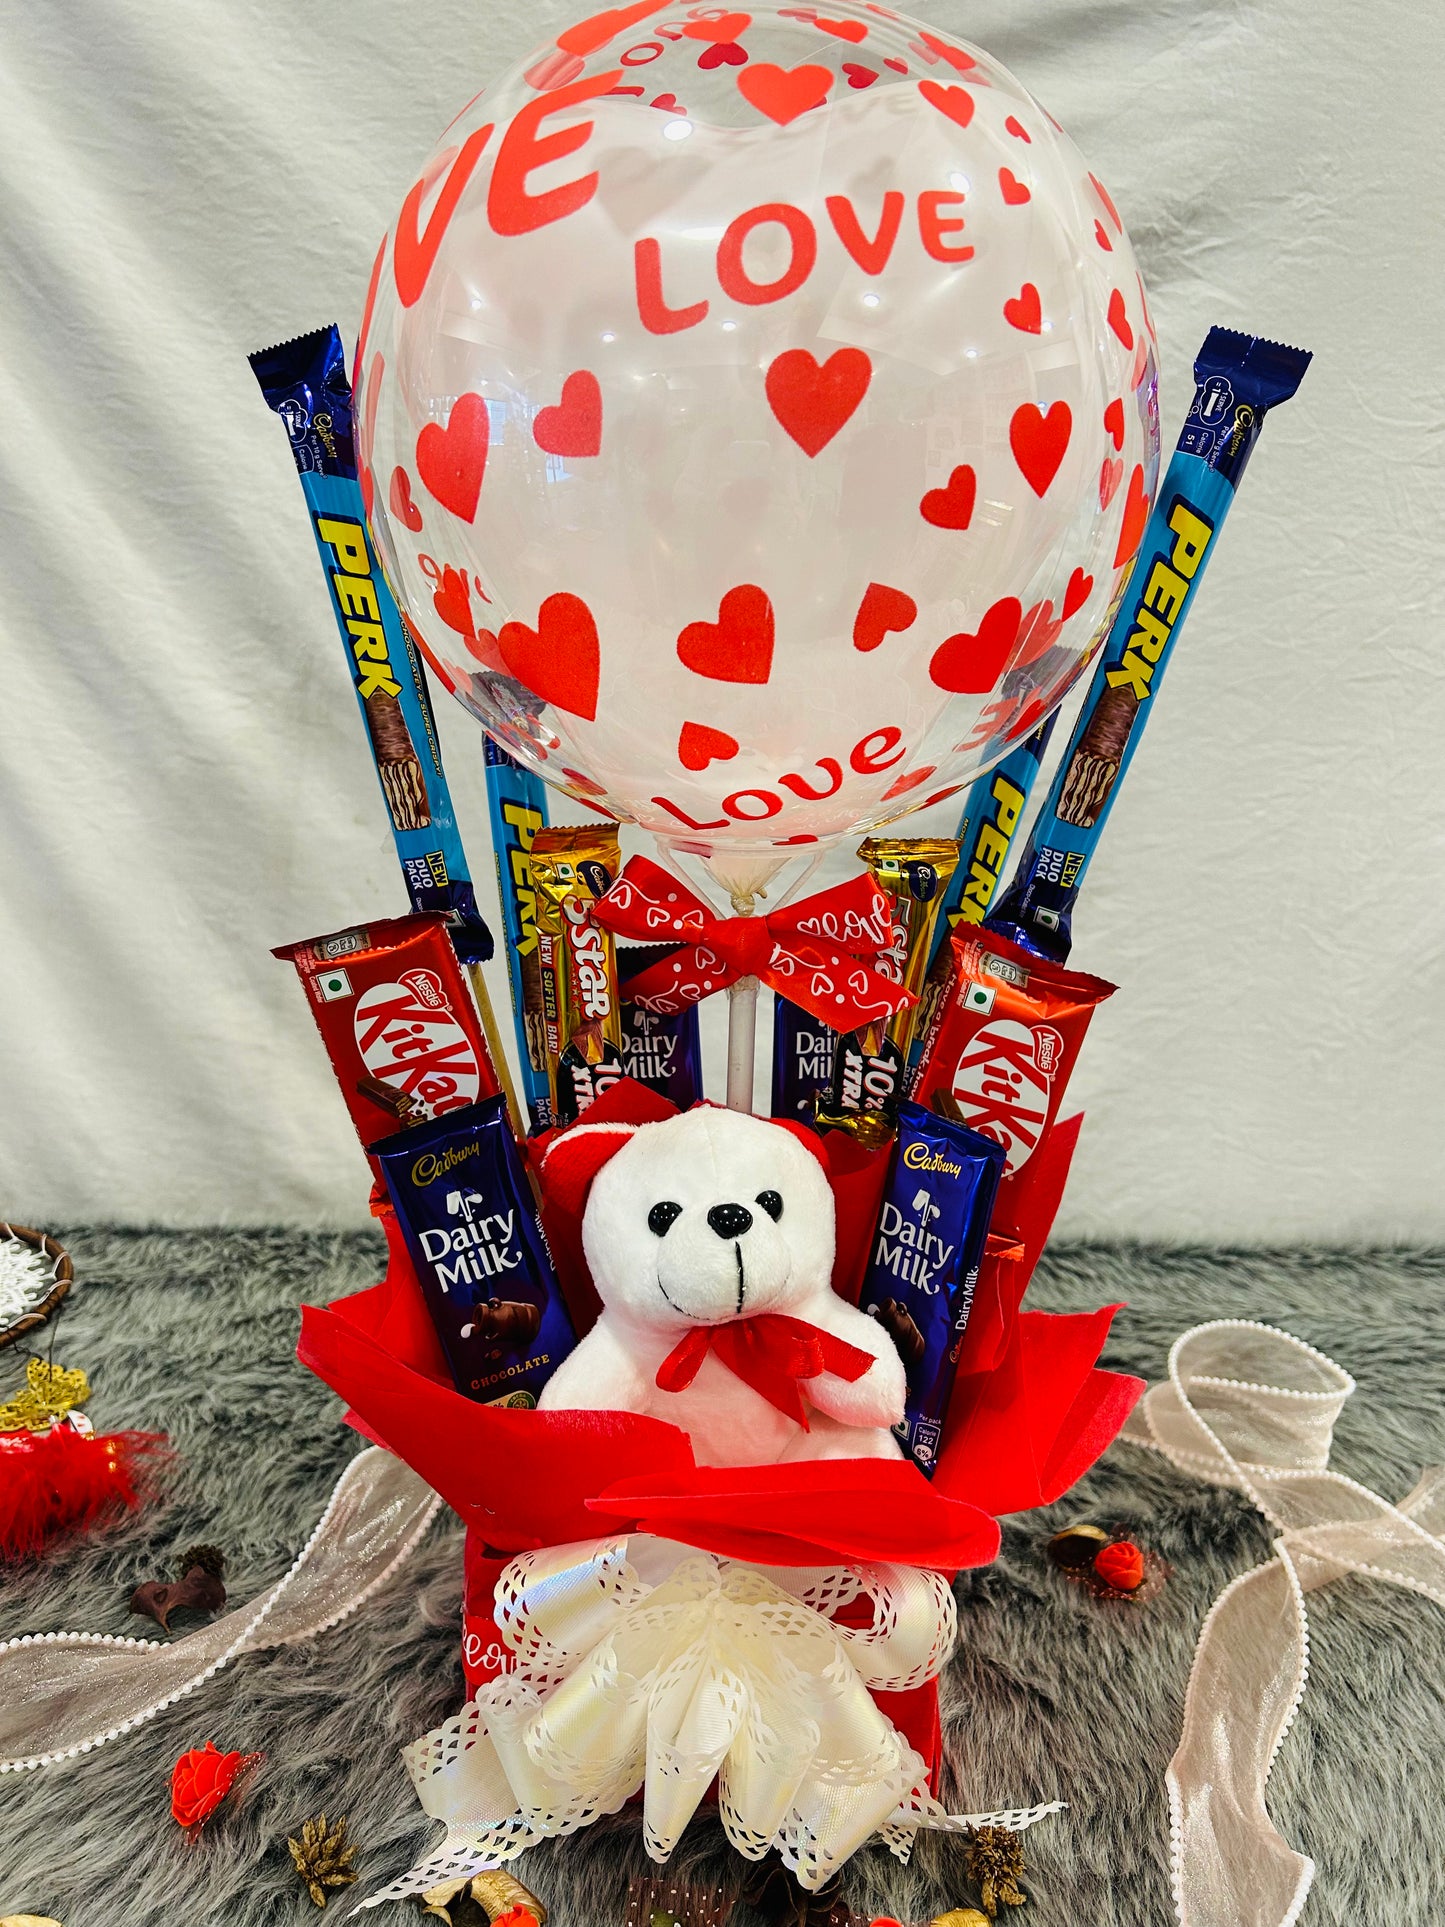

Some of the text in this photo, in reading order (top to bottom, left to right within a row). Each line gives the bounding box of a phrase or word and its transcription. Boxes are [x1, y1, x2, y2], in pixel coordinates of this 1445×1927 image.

[394, 69, 625, 308] VE
[634, 190, 976, 335] LOVE
[1185, 433, 1196, 446] 51
[316, 516, 403, 701] PERK
[1106, 503, 1213, 701] PERK
[420, 703, 432, 736] SUPER
[651, 726, 906, 830] Love
[427, 851, 448, 887] NEW
[948, 777, 1025, 929] PERK
[1035, 847, 1053, 880] PACK
[1047, 851, 1065, 883] DUO
[1061, 853, 1085, 888] NEW
[404, 860, 423, 890] PACK
[414, 859, 433, 888] DUO
[541, 935, 558, 1055] NEW SOFTER BAR!
[939, 972, 957, 1010] Have
[795, 1031, 837, 1056] Dai
[798, 1055, 834, 1080] Mil
[841, 1048, 864, 1109] XTRA
[864, 1056, 898, 1111] 10%
[571, 1064, 596, 1117] XTR
[953, 1030, 1048, 1178] KitKa
[536, 1099, 548, 1126] PACK
[411, 1141, 481, 1188] Cadbury
[903, 1141, 963, 1180] Cadbury
[418, 1208, 515, 1263] Dairy
[879, 1202, 955, 1270] Dairy
[955, 1296, 973, 1330] Dairy
[470, 1353, 551, 1391] CHOCOLATE
[918, 1434, 934, 1445] 122
[463, 1633, 517, 1676] lov
